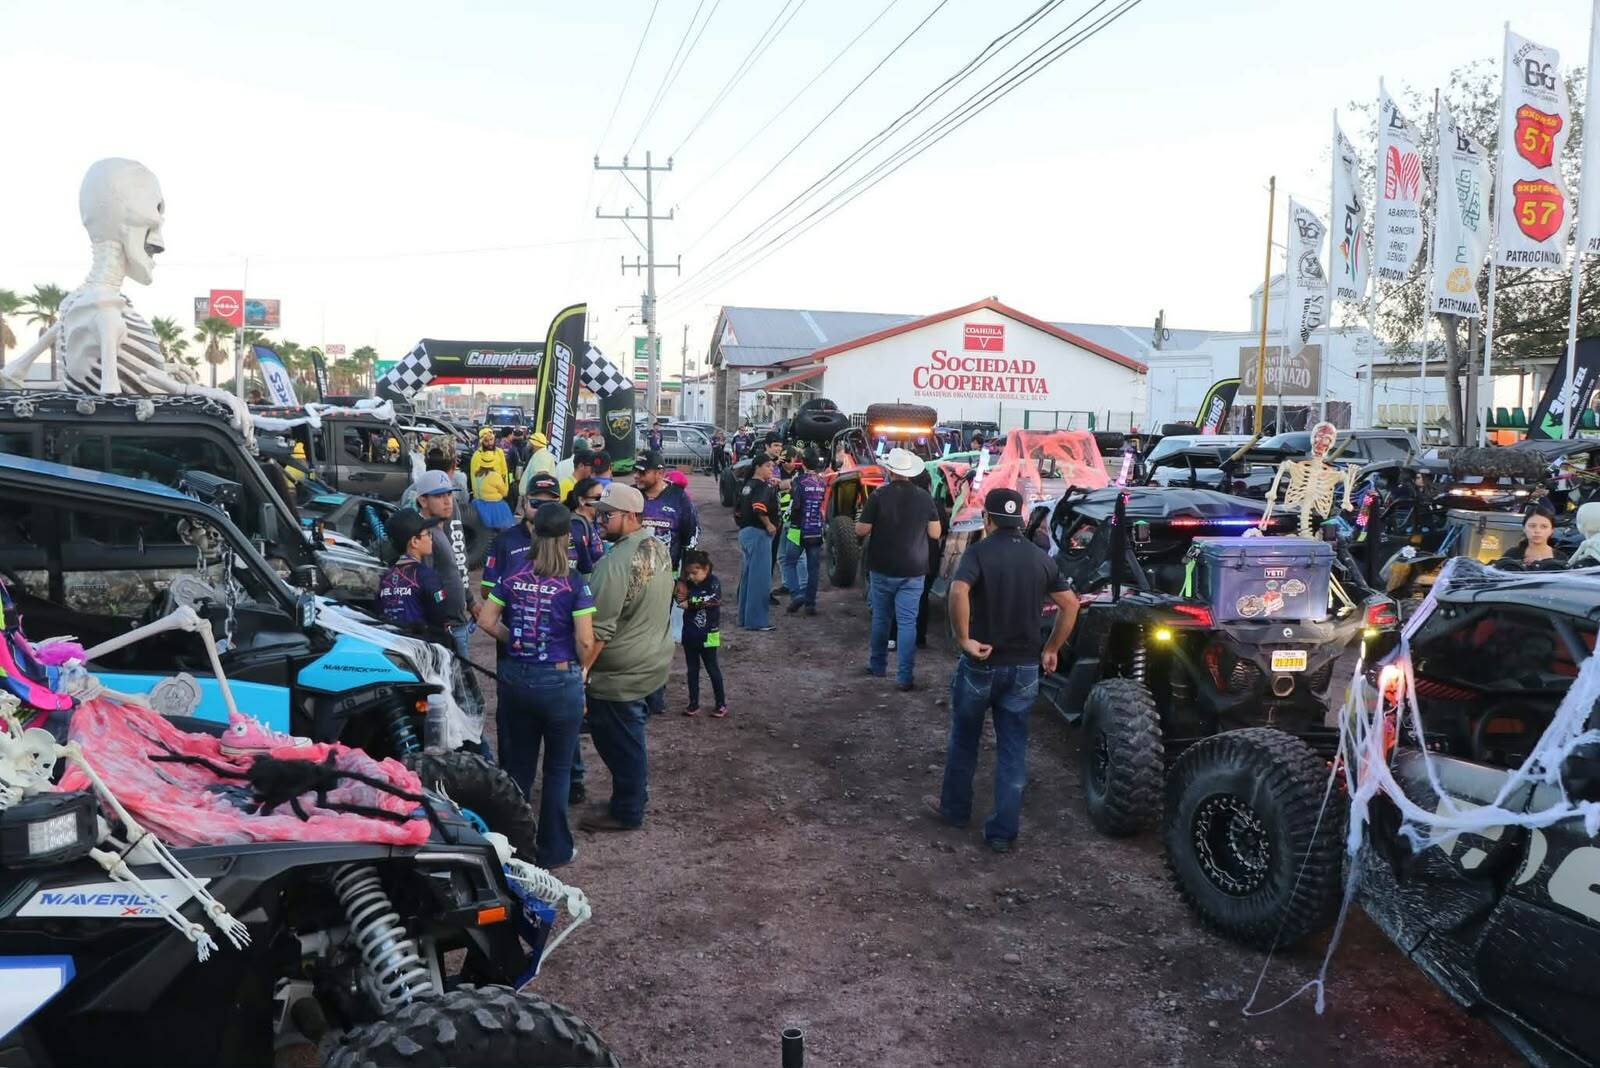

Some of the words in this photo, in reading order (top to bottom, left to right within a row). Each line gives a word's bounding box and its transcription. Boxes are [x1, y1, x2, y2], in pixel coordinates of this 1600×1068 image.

[1522, 127, 1551, 155] 57
[1521, 201, 1556, 226] 57
[965, 326, 1002, 336] COAHUILA
[930, 349, 1036, 374] SOCIEDAD
[913, 366, 1049, 393] COOPERATIVA
[1266, 569, 1283, 577] YETI
